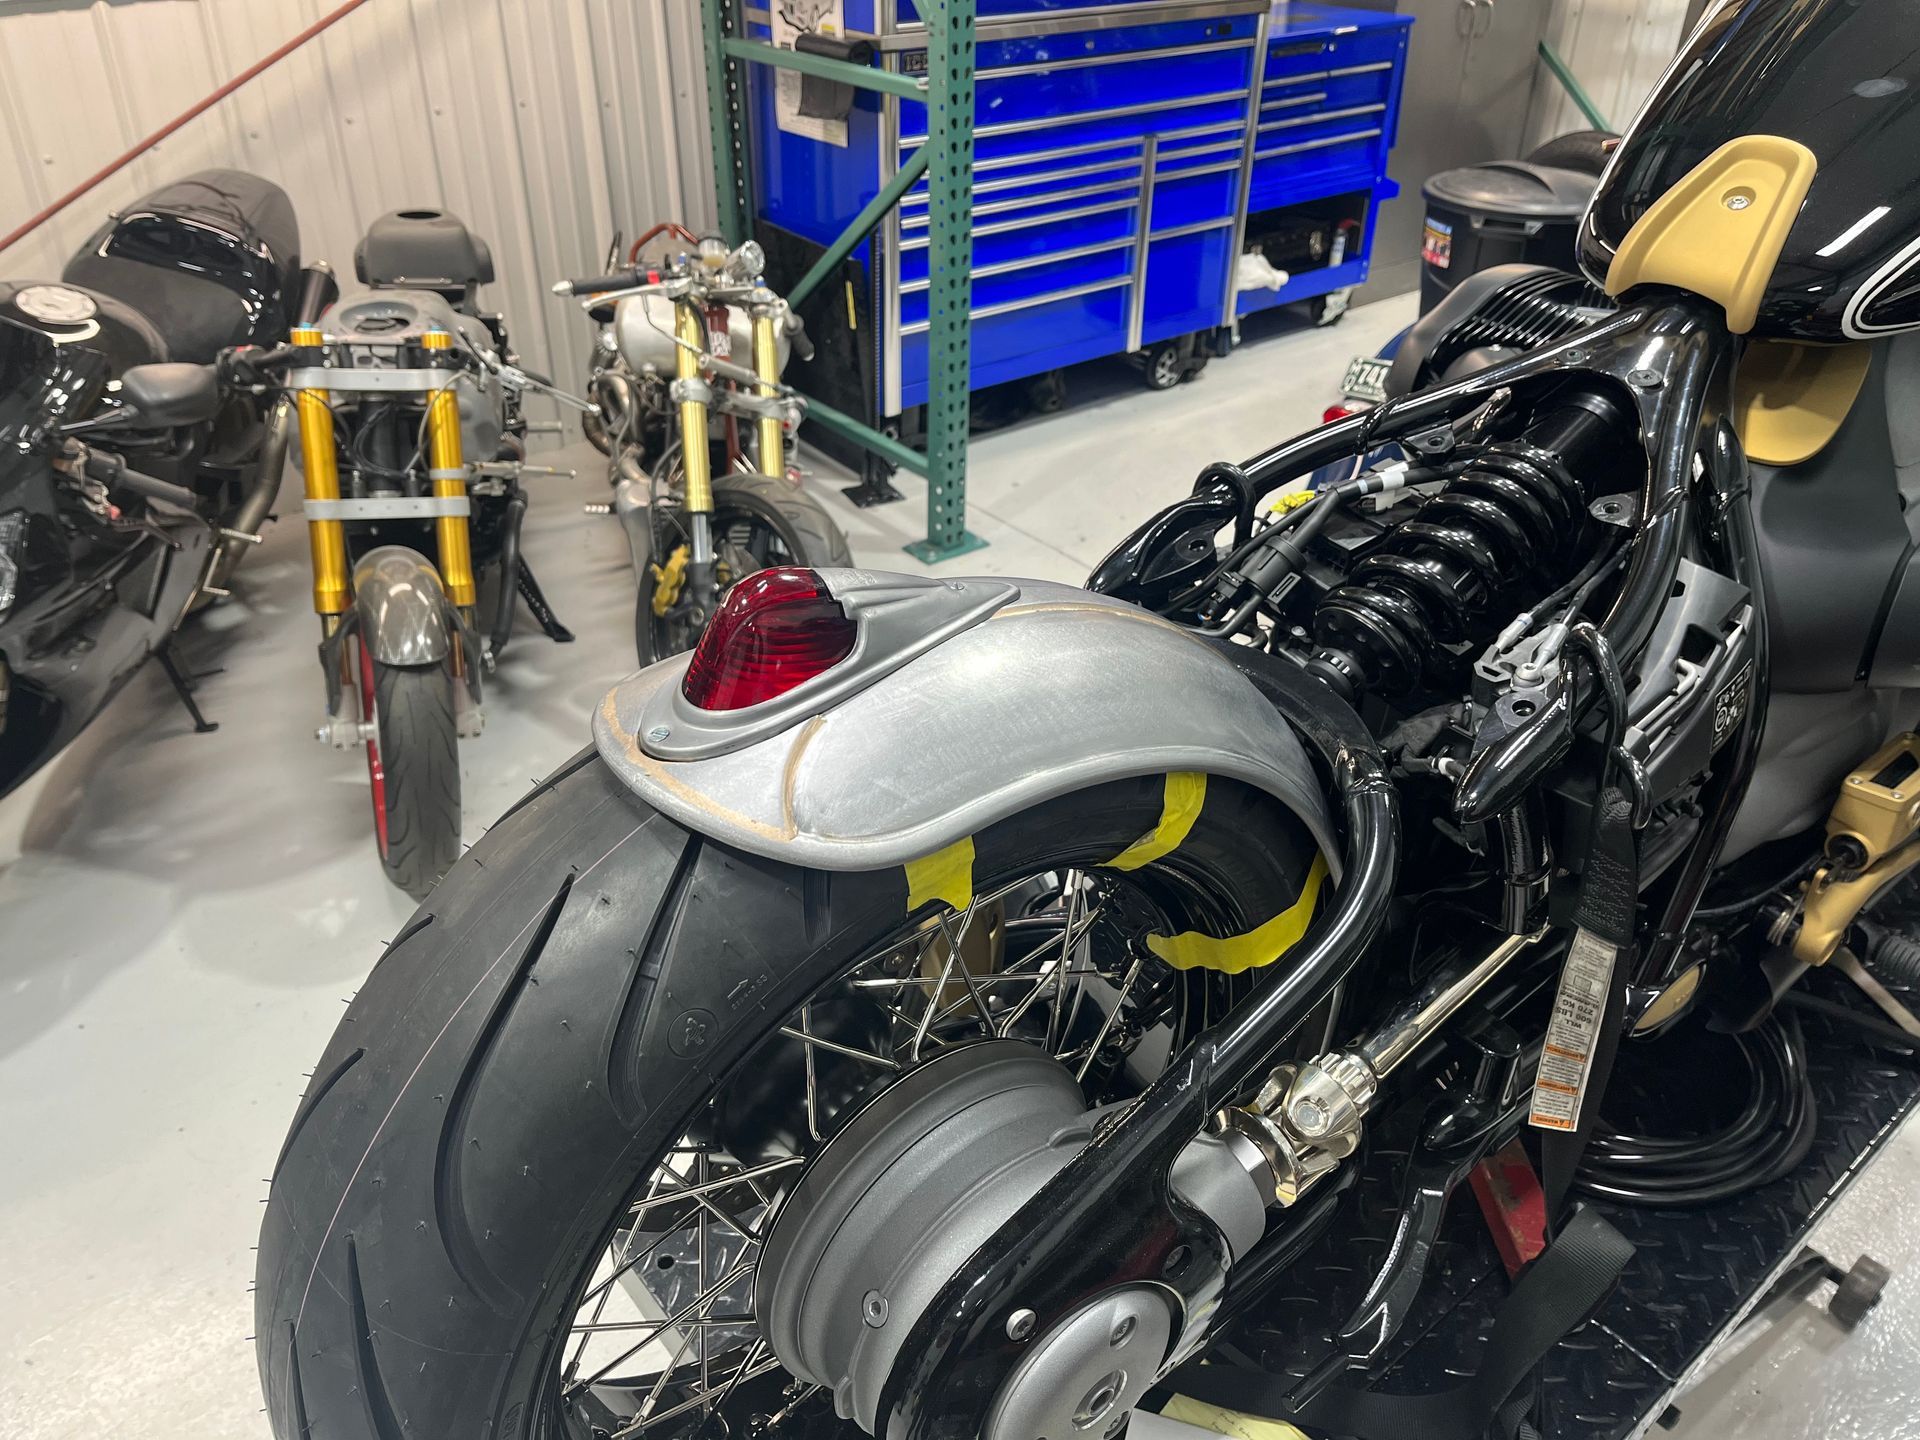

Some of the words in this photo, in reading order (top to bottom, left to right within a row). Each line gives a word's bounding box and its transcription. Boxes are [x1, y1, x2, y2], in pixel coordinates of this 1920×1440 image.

[1561, 999, 1576, 1009] KG
[1555, 1006, 1573, 1018] LBS
[1577, 1005, 1594, 1016] 270
[1564, 1018, 1582, 1029] WLL
